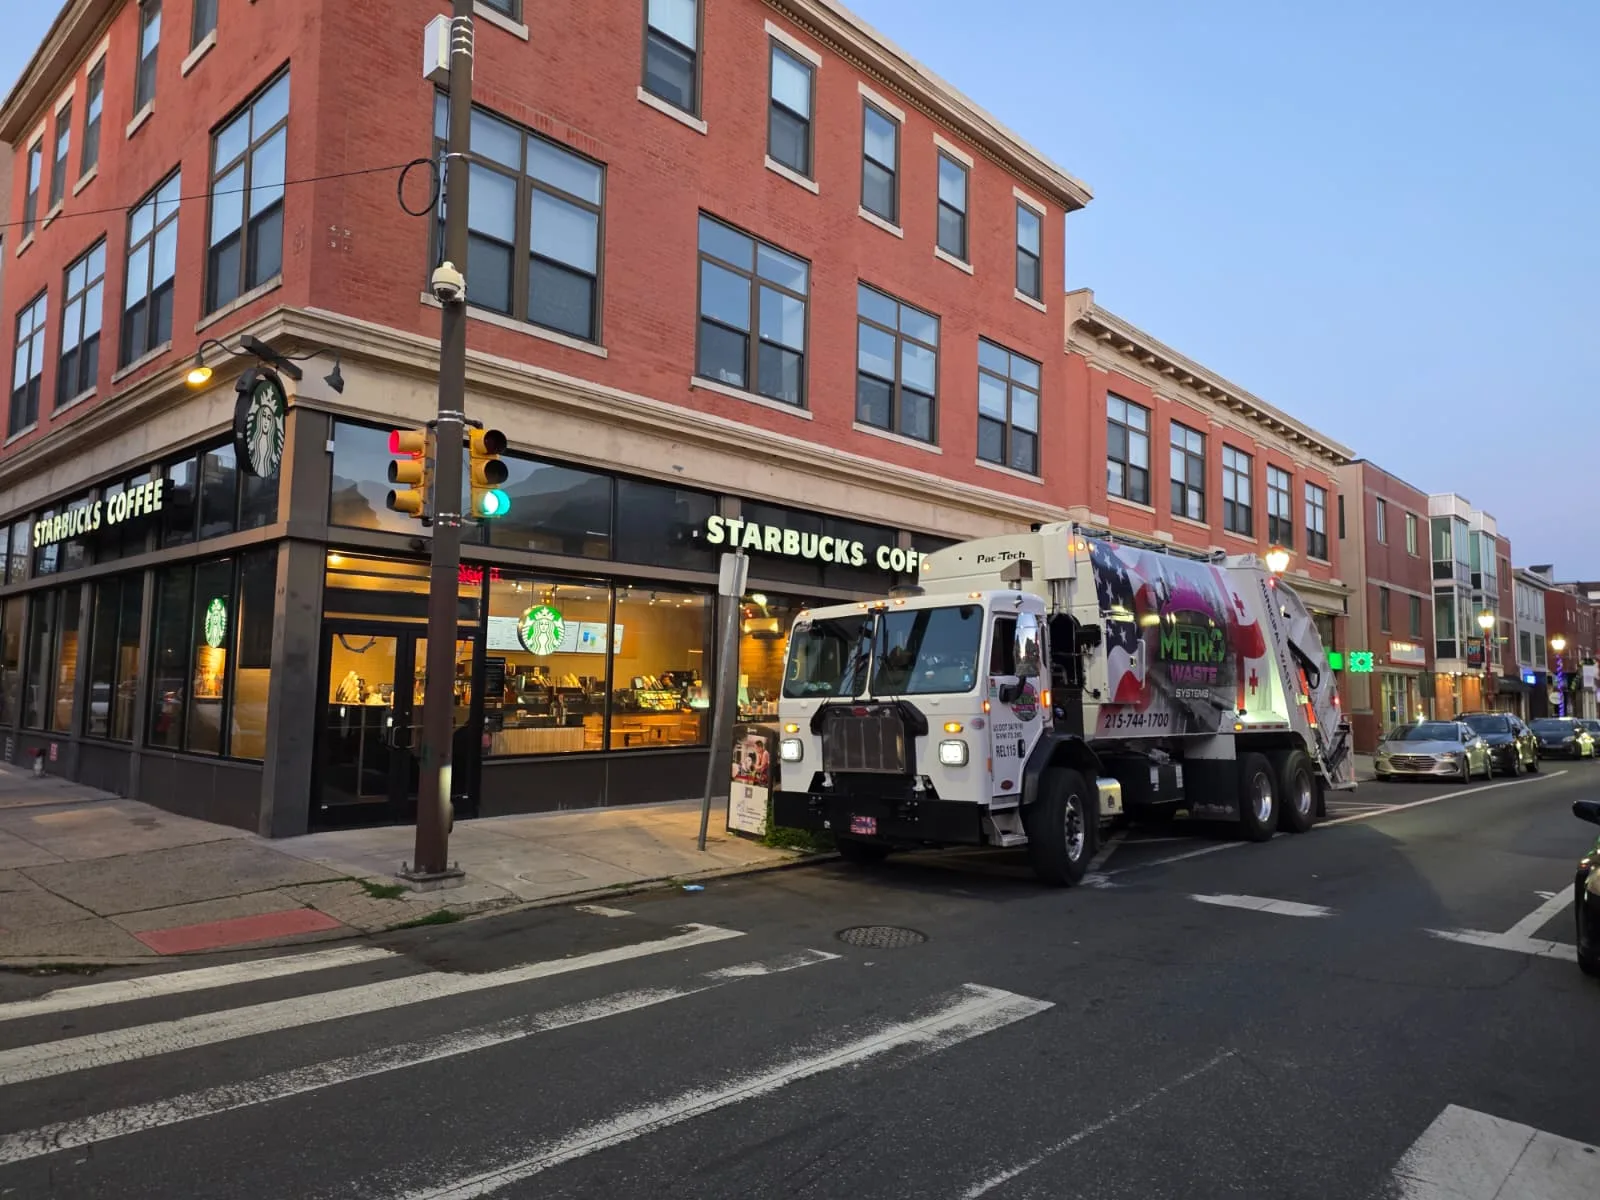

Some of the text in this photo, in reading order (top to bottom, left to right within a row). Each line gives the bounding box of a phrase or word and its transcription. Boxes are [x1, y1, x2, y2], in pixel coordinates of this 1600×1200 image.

[33, 478, 164, 548] STARBUCKS COFFEE
[706, 514, 864, 567] STARBUCKS
[977, 550, 1026, 565] Pac-Tech
[1160, 624, 1226, 663] METRO
[1260, 578, 1294, 692] MUNICIPAL WASTE
[1170, 664, 1218, 685] WASTE
[1175, 688, 1209, 698] SYSTEMS
[1104, 712, 1169, 729] 215-744-1700
